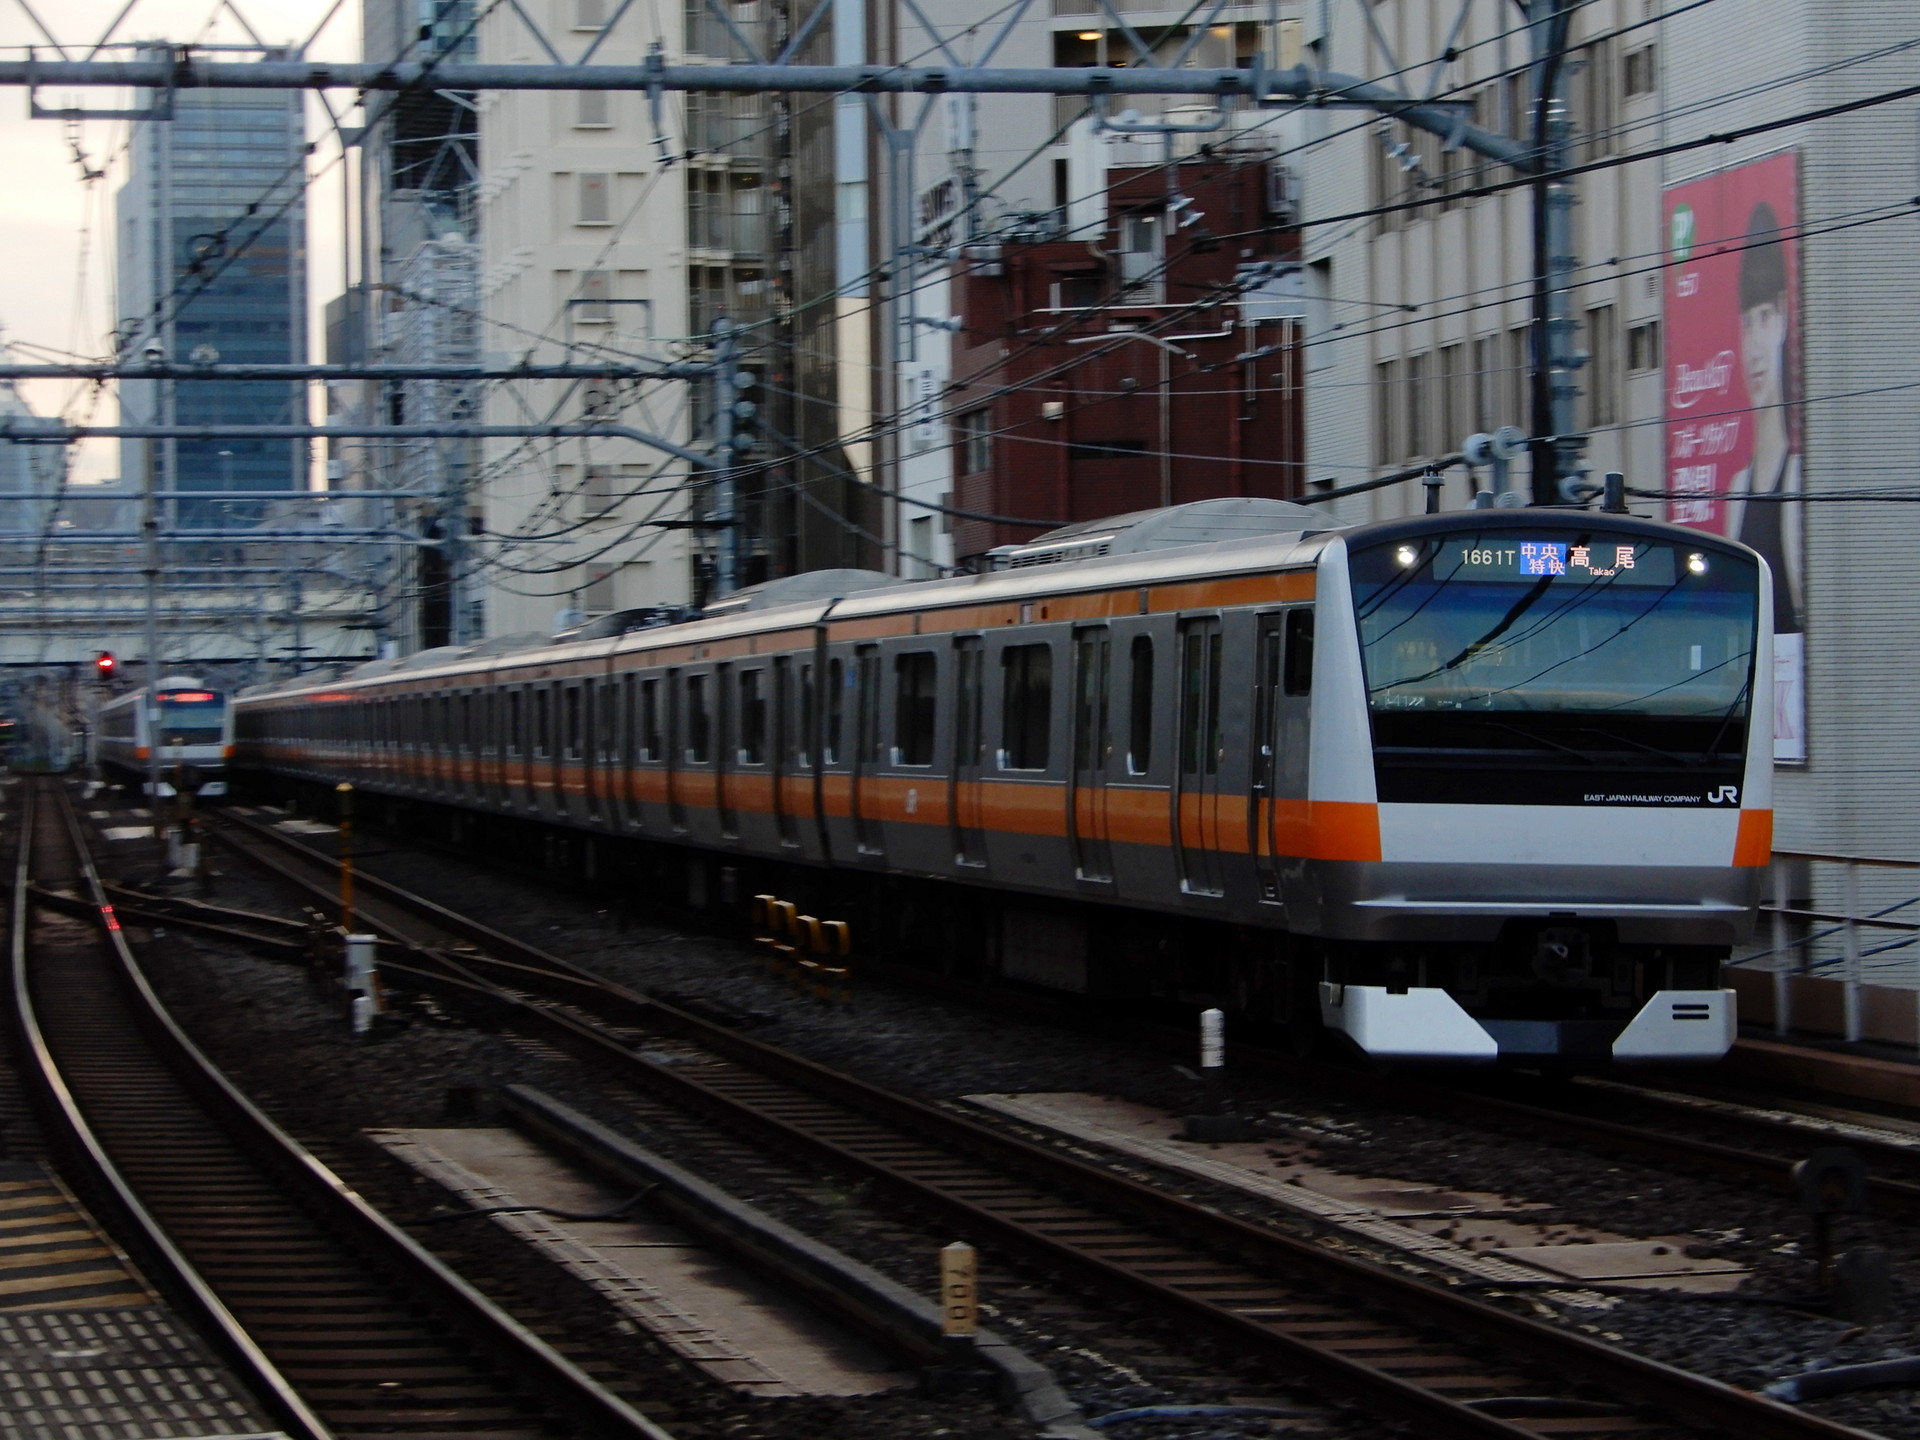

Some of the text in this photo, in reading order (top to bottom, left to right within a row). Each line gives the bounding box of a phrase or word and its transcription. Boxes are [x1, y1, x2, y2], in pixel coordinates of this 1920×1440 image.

[1461, 549, 1515, 565] 1661T
[1521, 544, 1558, 559] 中央
[1570, 546, 1635, 569] 高尾
[1529, 559, 1565, 574] 特快
[1588, 567, 1615, 576] Takao
[1583, 794, 1701, 804] EAST JAPAN RAILWAY COMPANY
[1707, 785, 1738, 804] JR
